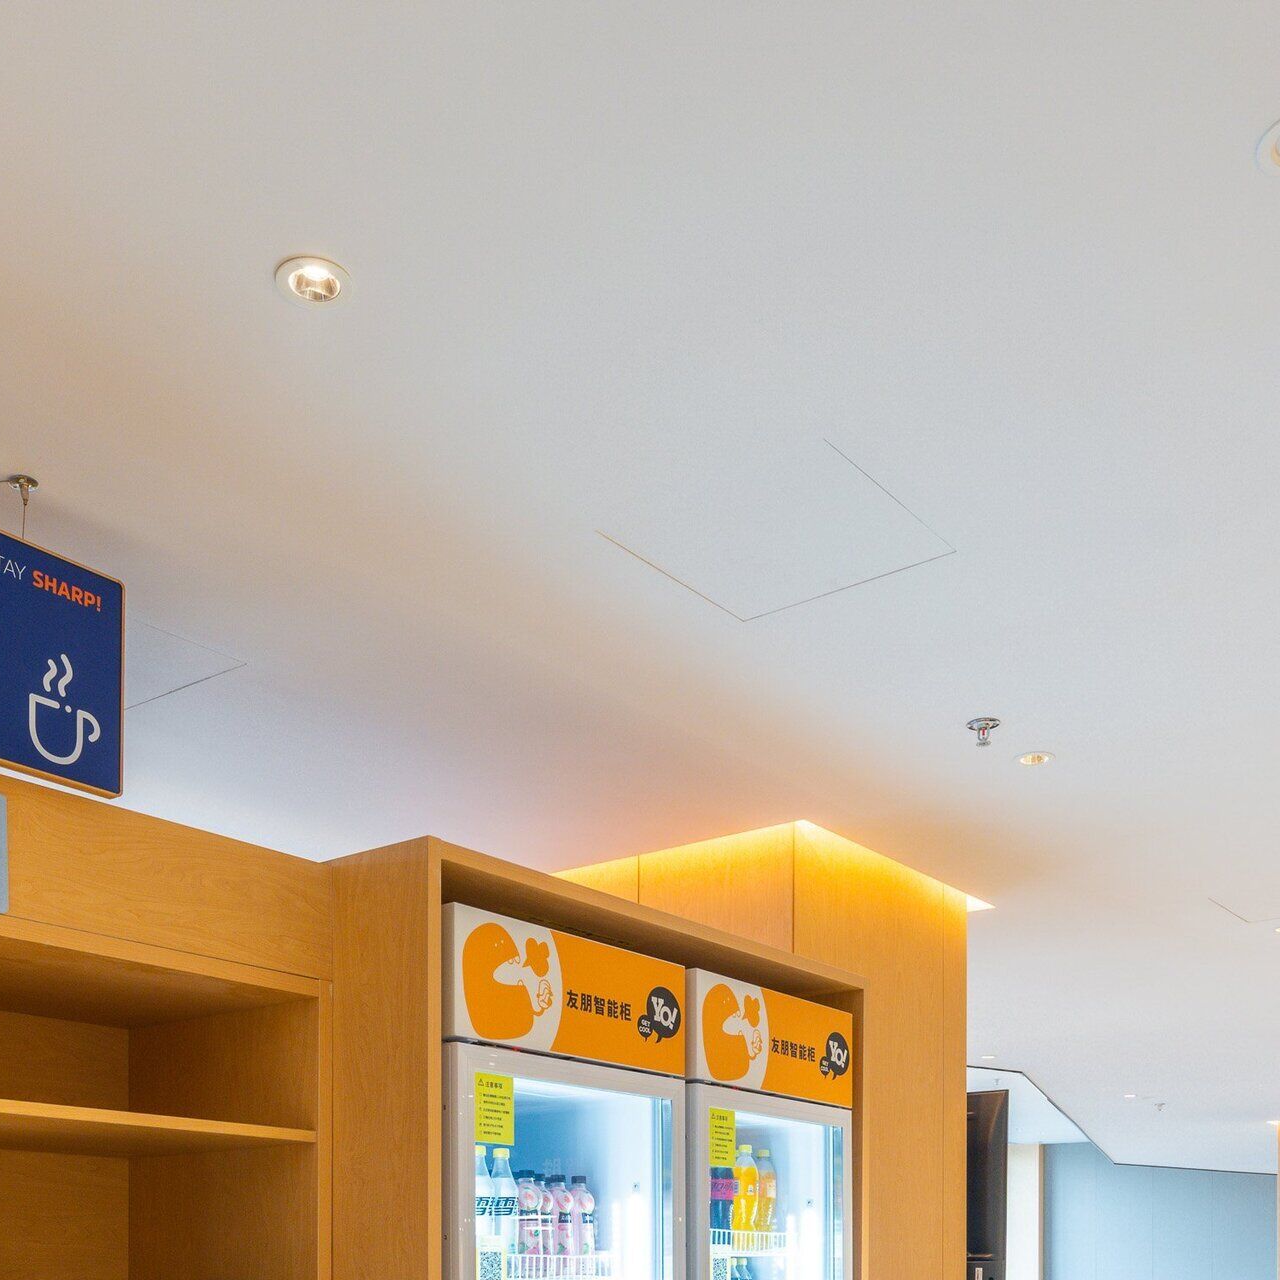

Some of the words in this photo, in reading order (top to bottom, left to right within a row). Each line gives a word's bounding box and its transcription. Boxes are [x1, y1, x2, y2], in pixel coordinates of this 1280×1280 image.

[31, 569, 103, 614] SHARP!
[566, 989, 632, 1022] 友朋智能柜
[638, 1025, 651, 1034] COOL
[640, 1018, 651, 1027] GET
[771, 1036, 816, 1063] 友朋智能柜
